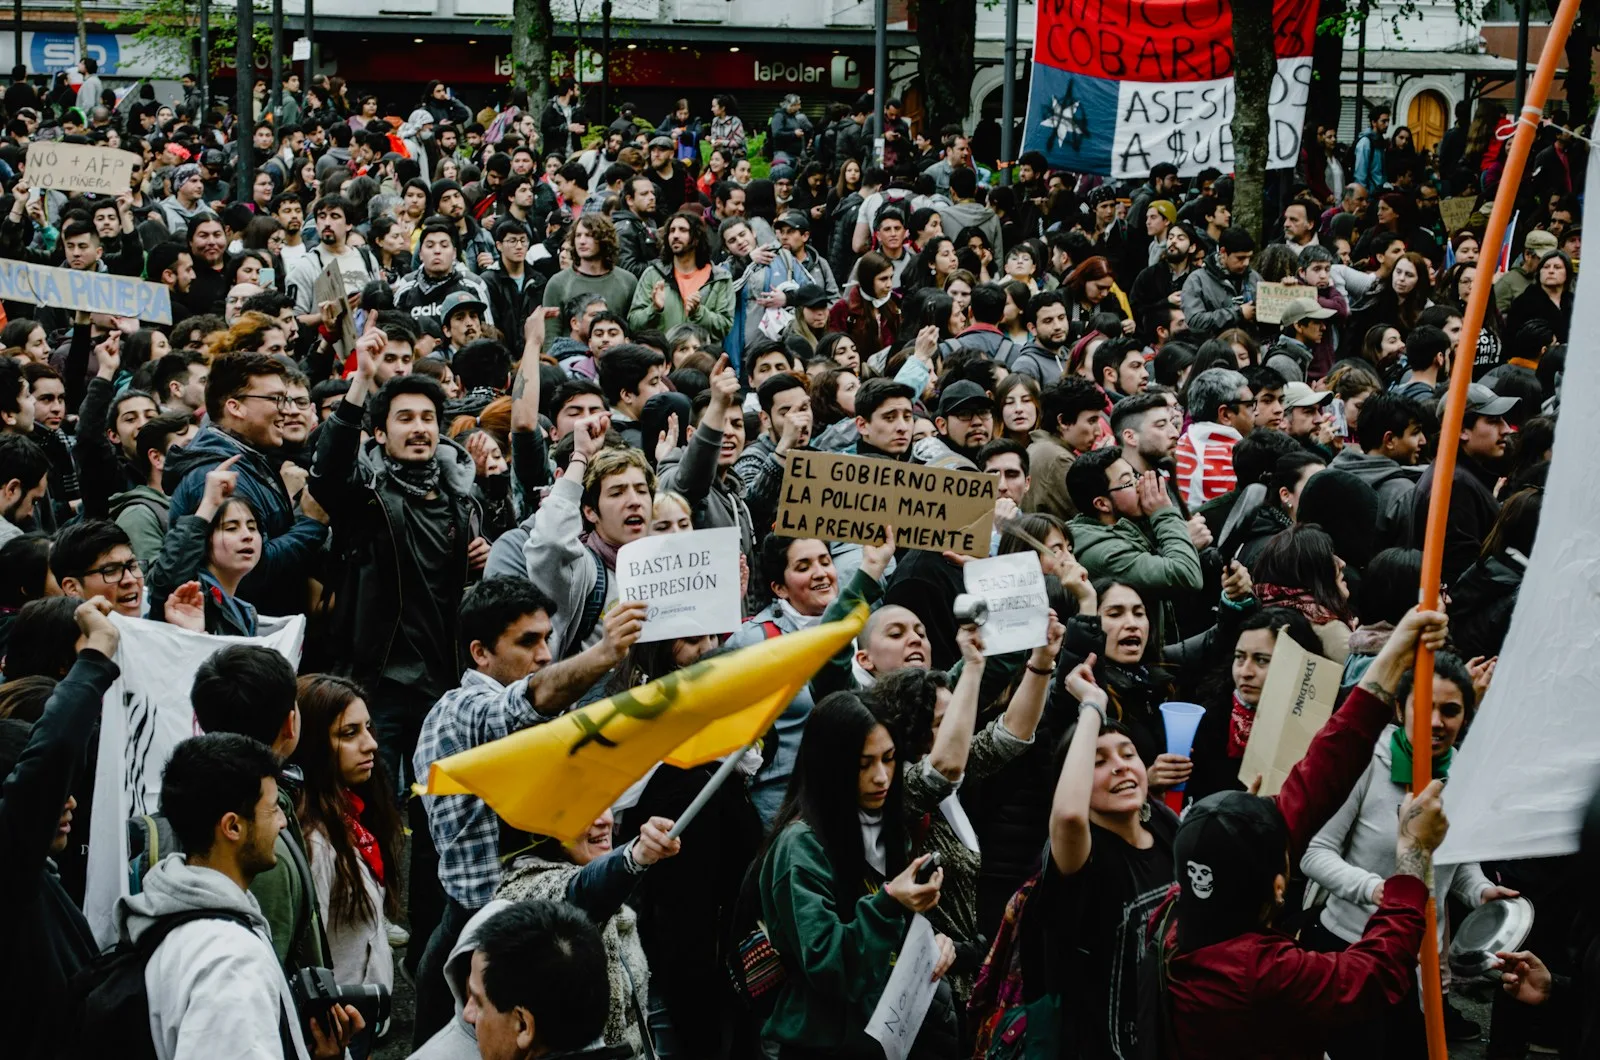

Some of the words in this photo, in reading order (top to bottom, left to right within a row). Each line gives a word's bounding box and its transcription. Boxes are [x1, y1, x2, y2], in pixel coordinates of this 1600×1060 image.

[1047, 16, 1305, 80] COBARDS
[754, 60, 825, 82] laPolar
[1124, 64, 1312, 123] ASESIOS
[29, 151, 58, 167] NO
[85, 155, 124, 175] AFP
[1119, 133, 1151, 172] A
[27, 173, 53, 187] NO
[69, 270, 173, 324] PIÑERA
[791, 457, 817, 480] EL
[830, 461, 937, 492] GOBIERNO
[942, 476, 994, 499] ROBA
[785, 484, 811, 504] LA
[821, 487, 887, 513] POLICIA
[898, 497, 947, 521] MATA
[781, 510, 808, 531] LA
[815, 516, 887, 544] PRENSA
[896, 526, 975, 551] MIENTE
[629, 554, 683, 577] BASTA
[688, 550, 711, 568] DE
[625, 571, 717, 601] REPRESIÓN
[1292, 658, 1317, 717] SPALDING
